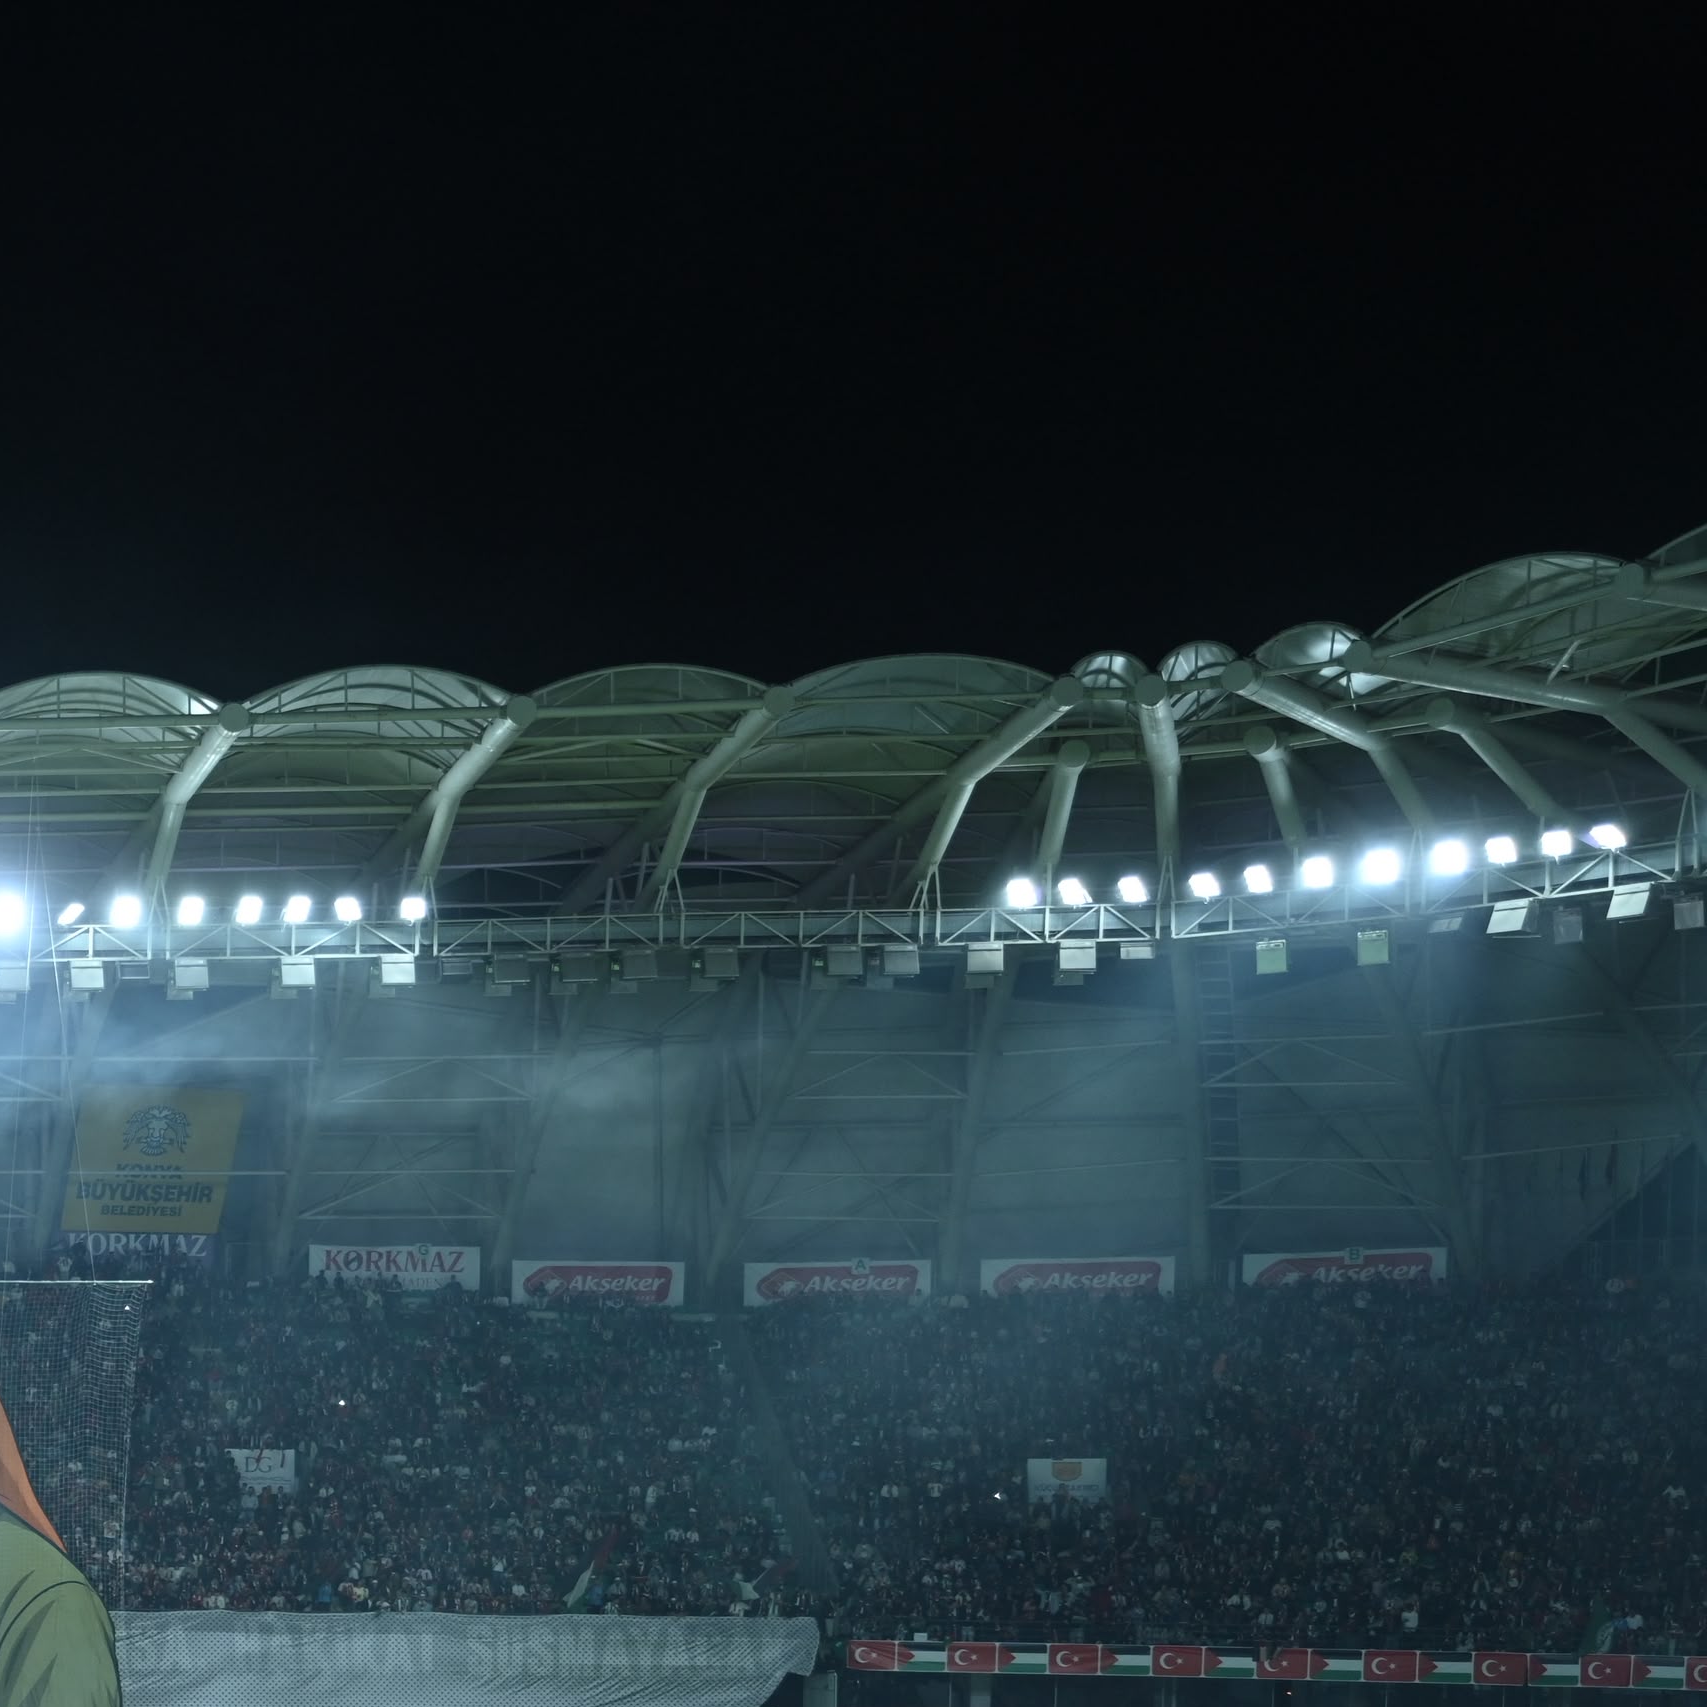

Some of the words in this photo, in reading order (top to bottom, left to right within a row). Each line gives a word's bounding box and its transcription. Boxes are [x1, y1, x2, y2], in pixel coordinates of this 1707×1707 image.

[114, 1164, 184, 1180] KONYA
[75, 1179, 214, 1206] BÜYÜKŞEHİR
[100, 1204, 183, 1217] BELEDİYESİ
[324, 1249, 466, 1273] KORKMAZ
[1348, 1248, 1361, 1261] B
[854, 1259, 867, 1271] A
